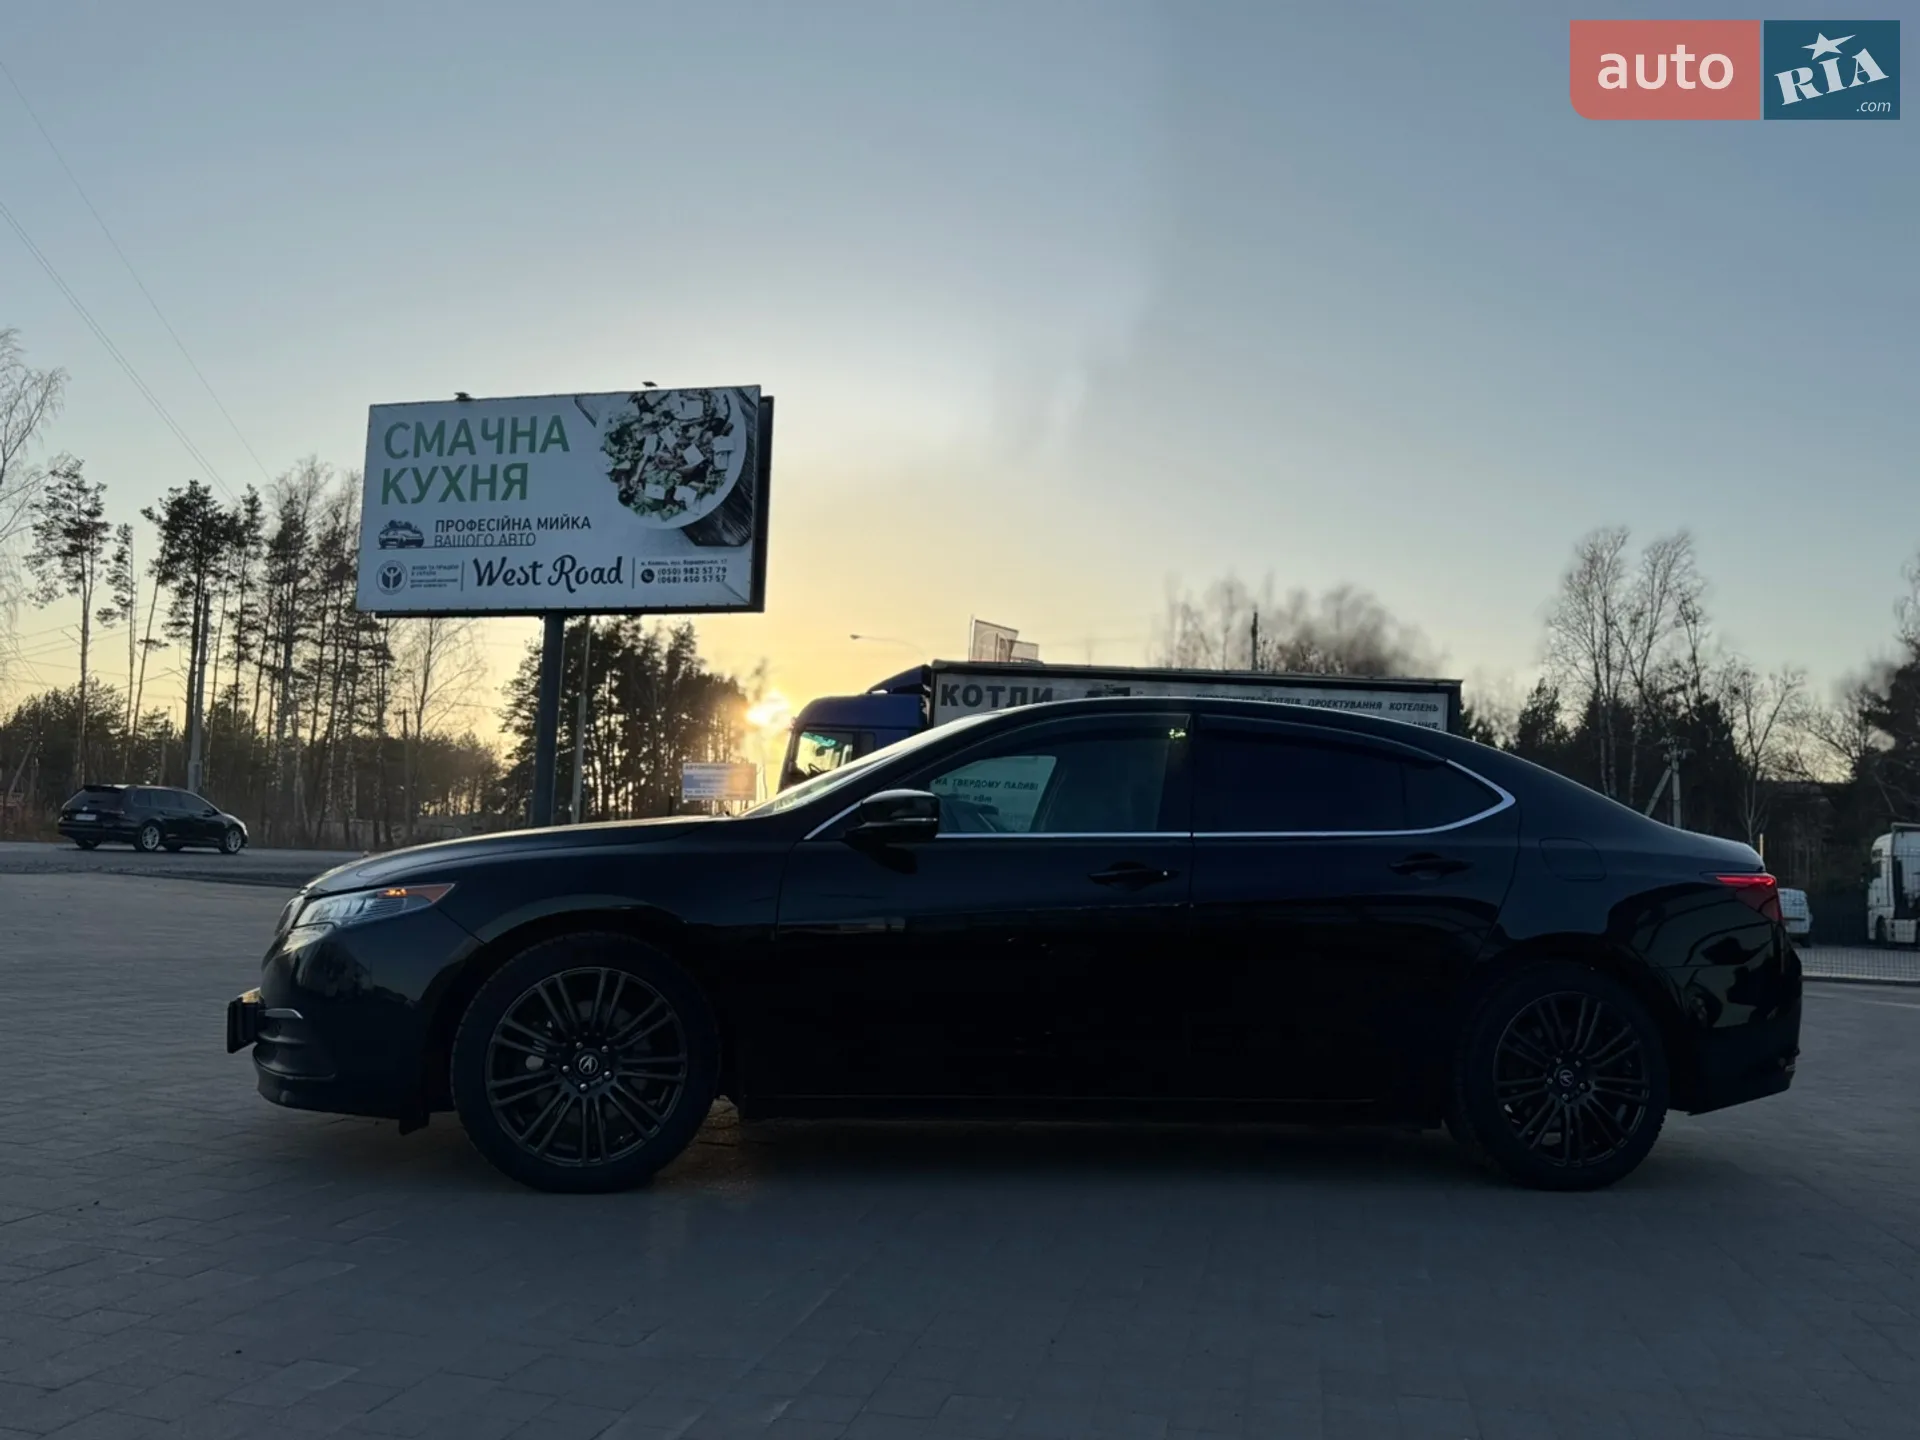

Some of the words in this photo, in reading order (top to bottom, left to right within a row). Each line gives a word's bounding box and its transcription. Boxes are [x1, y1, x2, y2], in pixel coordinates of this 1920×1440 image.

[384, 414, 570, 460] СМАЧНА
[380, 462, 530, 505] КУХНЯ
[434, 515, 532, 533] ПРОФЕСІЙНА
[536, 513, 592, 531] МИЙКА
[434, 533, 495, 548] ВАШОГО
[499, 532, 537, 547] АВТО
[472, 556, 542, 588] West
[547, 553, 624, 594] Road
[940, 684, 1053, 707] КОТЛИ
[1388, 702, 1440, 712] КОТЕЛЕНЬ
[952, 779, 1001, 789] ТВЕРДОМУ
